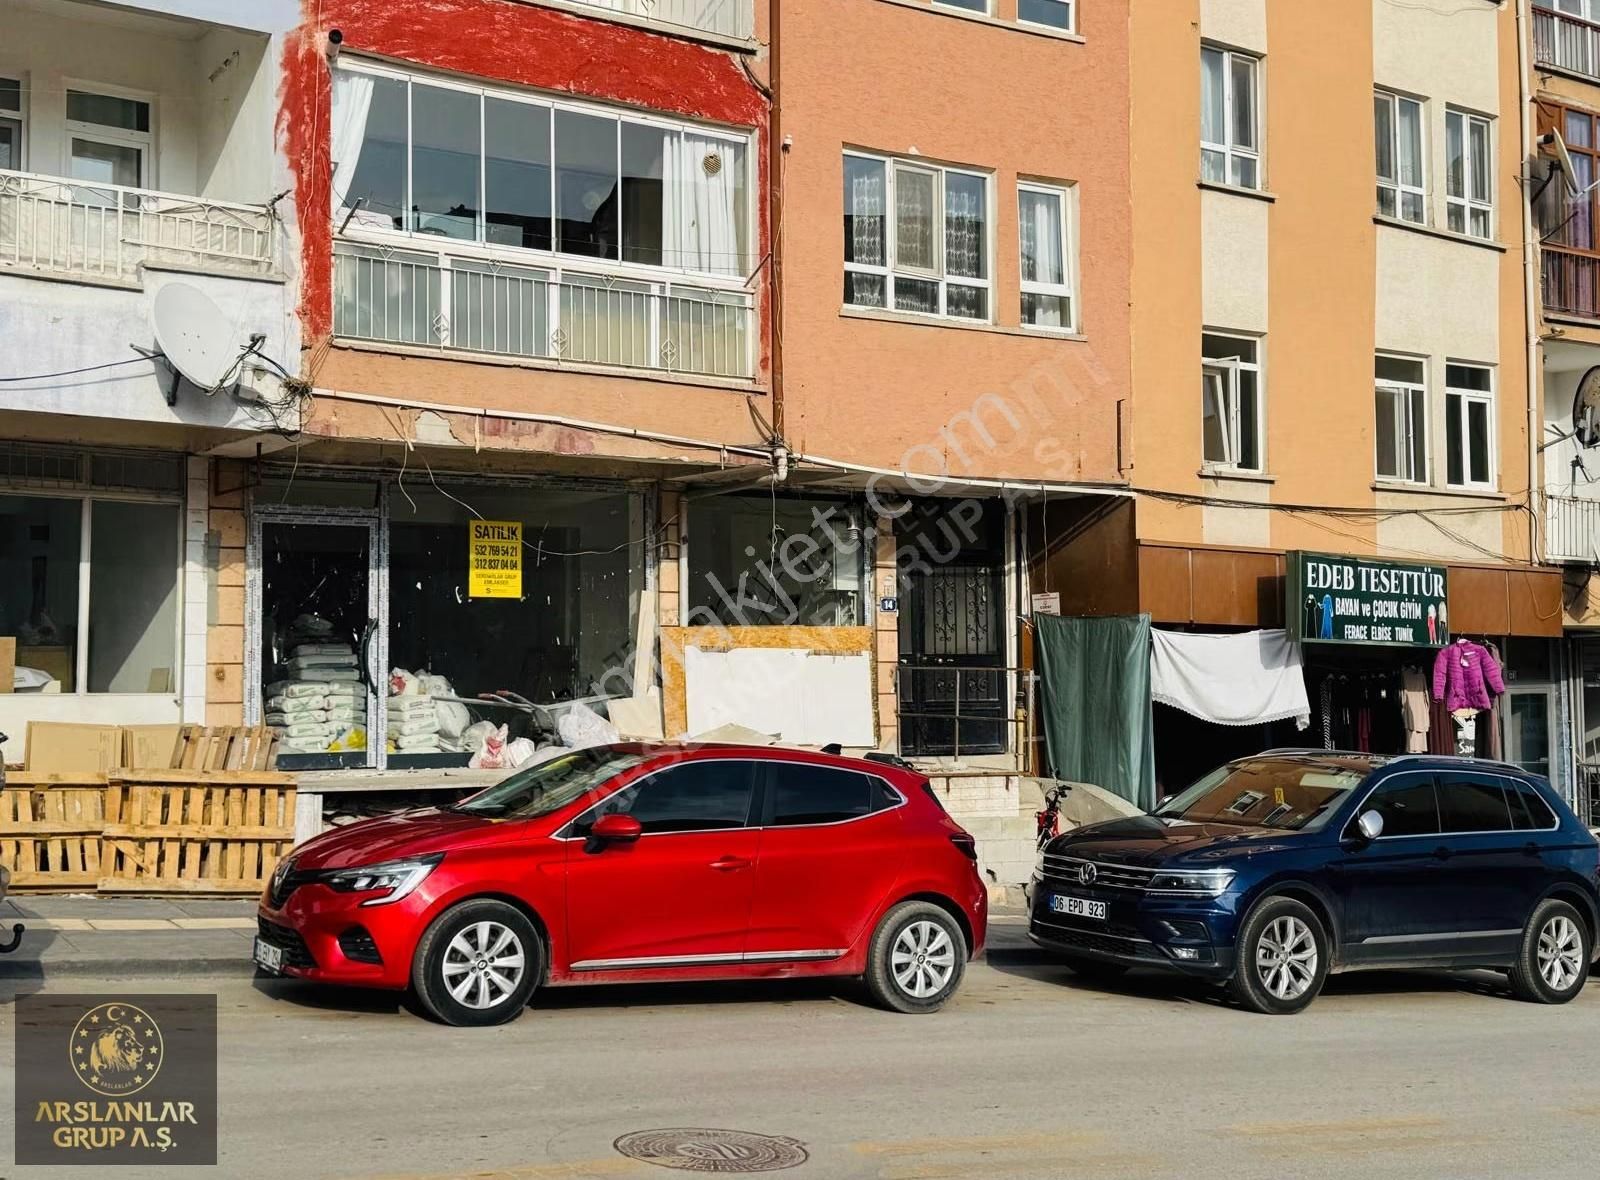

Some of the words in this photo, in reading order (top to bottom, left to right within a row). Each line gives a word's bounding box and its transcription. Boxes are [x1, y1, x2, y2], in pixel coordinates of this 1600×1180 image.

[474, 524, 519, 541] SATILIK
[474, 545, 487, 556] 532
[488, 545, 500, 557] 769
[501, 546, 509, 557] 54
[510, 546, 518, 557] 21
[474, 558, 487, 570] 312
[488, 559, 500, 571] 837
[501, 559, 509, 571] 04
[510, 559, 518, 571] 04
[1306, 562, 1354, 590] EDEB
[1358, 567, 1446, 598] TESETTÜR
[884, 600, 893, 610] 14
[1335, 597, 1359, 616] BAYAN
[1361, 602, 1371, 617] ve
[1373, 600, 1398, 622] ÇOCUK
[1400, 598, 1422, 620] GİYİM
[1344, 624, 1368, 640] FERACE
[1371, 623, 1392, 641] ELBİSE
[1055, 896, 1064, 911] 06
[1068, 899, 1084, 914] EPD
[1088, 902, 1105, 917] 923
